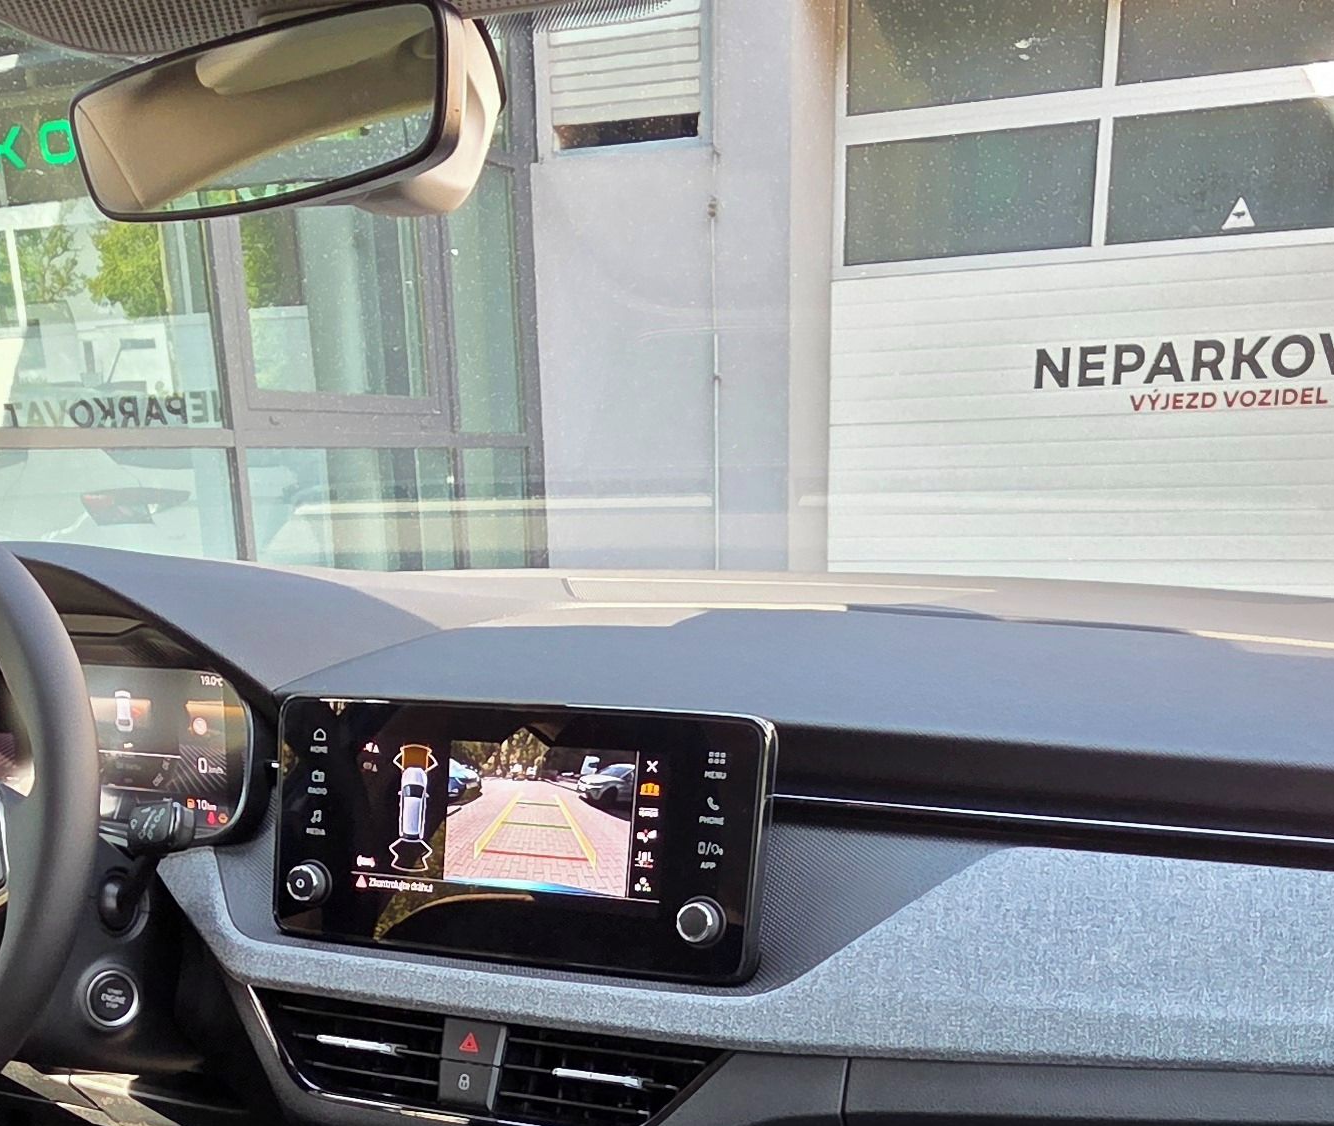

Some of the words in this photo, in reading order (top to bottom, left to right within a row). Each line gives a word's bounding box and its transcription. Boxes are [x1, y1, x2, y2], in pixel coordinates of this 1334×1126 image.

[1130, 389, 1217, 411] VÝJEZD
[1226, 387, 1328, 409] VOZIDEL
[198, 757, 208, 774] 0
